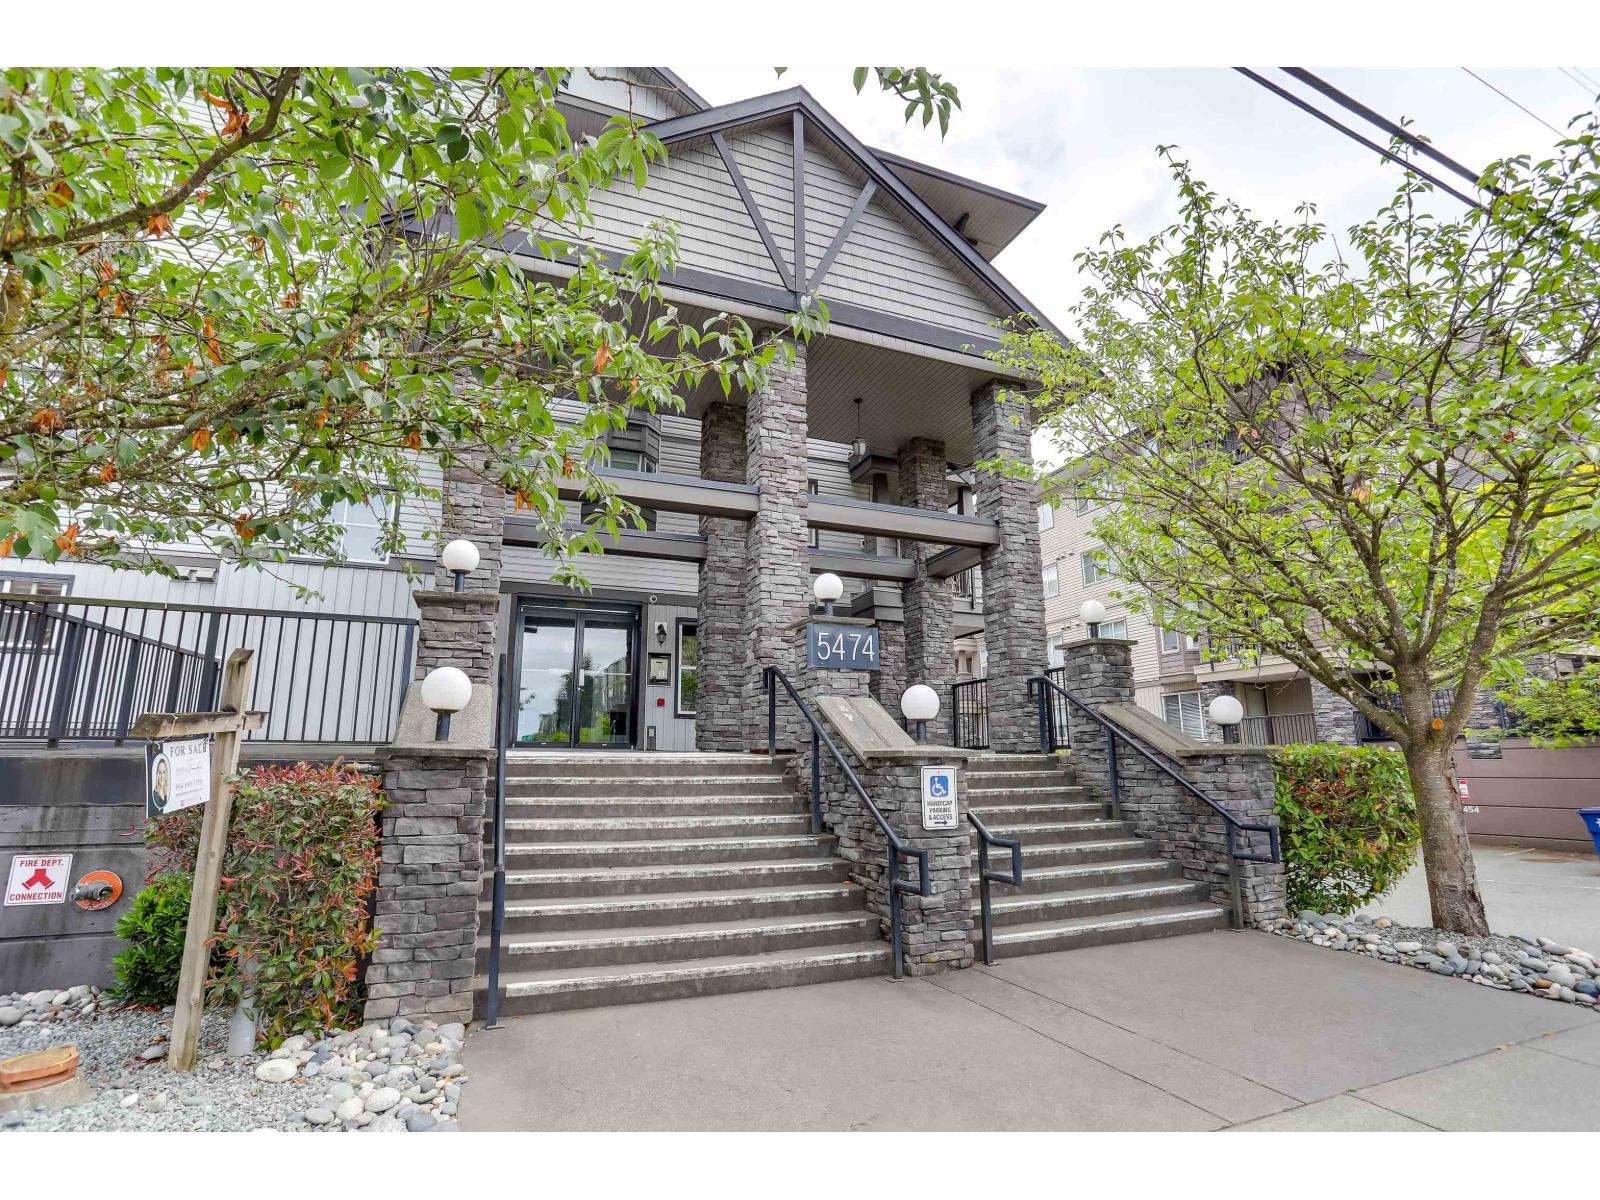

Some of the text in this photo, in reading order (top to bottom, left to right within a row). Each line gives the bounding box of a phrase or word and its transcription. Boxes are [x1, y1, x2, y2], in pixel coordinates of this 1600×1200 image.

[817, 632, 875, 662] 5474
[170, 745, 186, 758] FOR
[933, 813, 953, 821] ACCESS
[20, 859, 64, 868] FIRE DEPT.
[9, 891, 63, 901] CONNECTION
